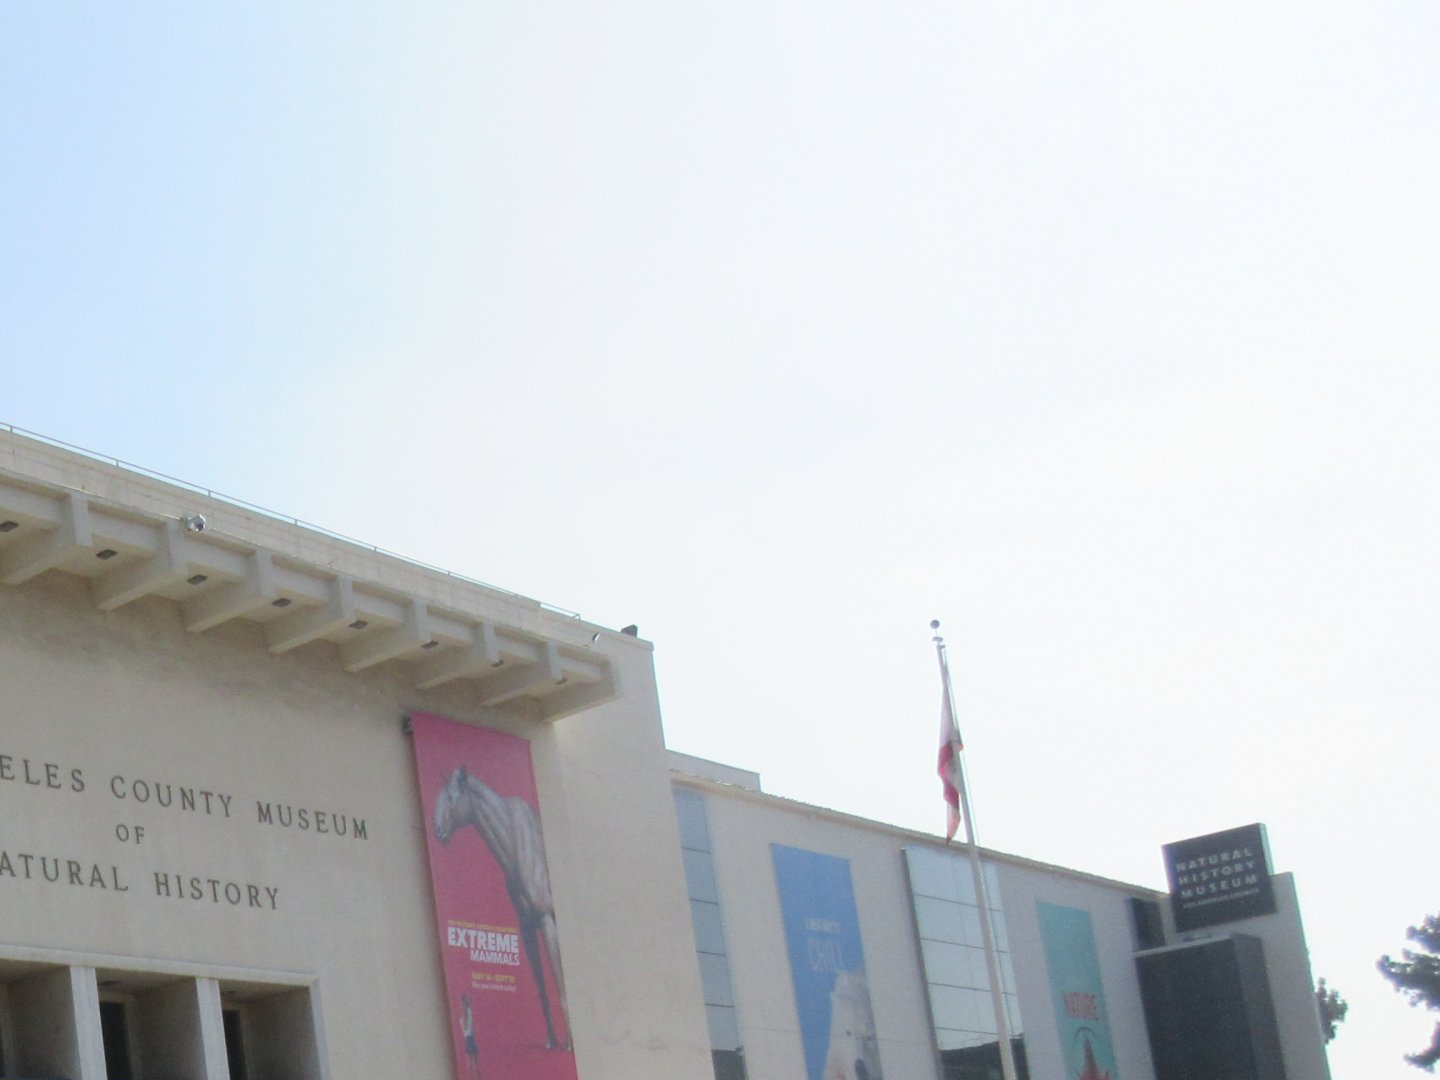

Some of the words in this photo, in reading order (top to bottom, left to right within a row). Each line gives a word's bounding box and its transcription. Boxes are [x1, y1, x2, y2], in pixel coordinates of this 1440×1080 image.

[111, 775, 233, 818] COUNTY
[256, 801, 369, 840] MUSEUM
[115, 823, 145, 845] OF
[1176, 848, 1252, 872] NATURAL
[1178, 861, 1255, 885] HISTORY
[154, 872, 279, 909] HISTORY
[1181, 874, 1257, 897] MUSEUM
[447, 926, 520, 954] EXTREME
[470, 949, 520, 966] MAMMALS
